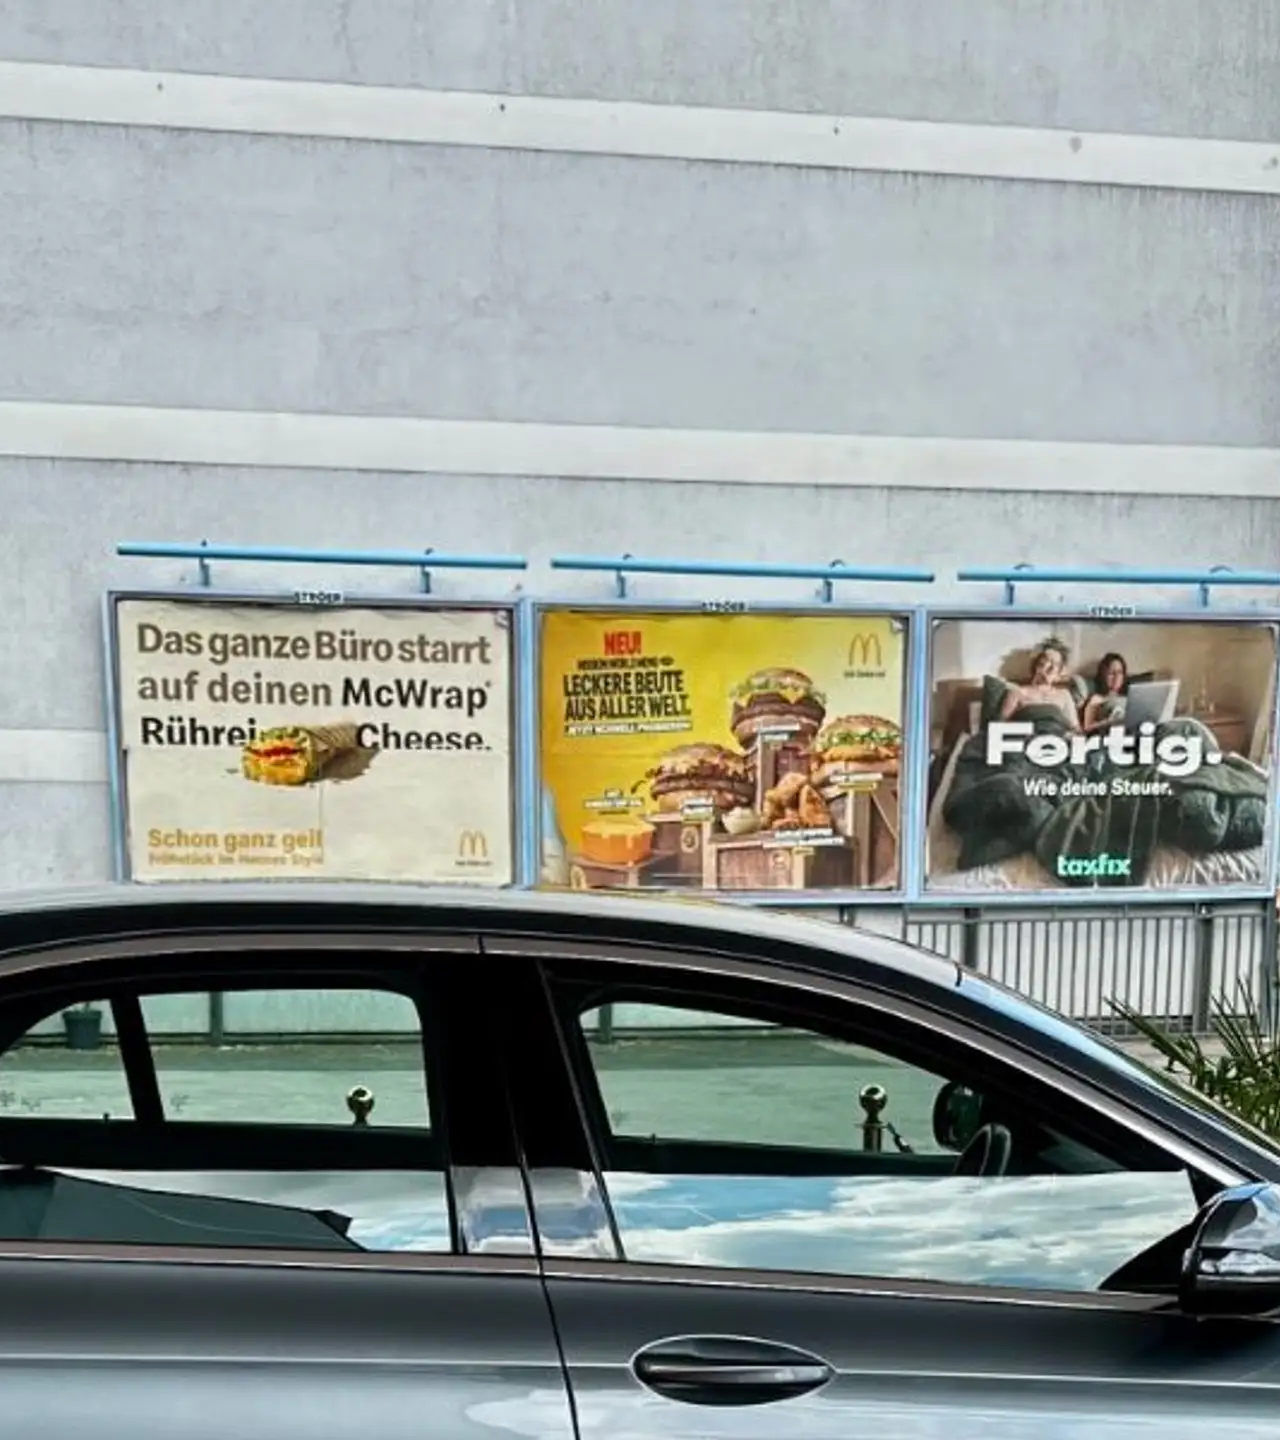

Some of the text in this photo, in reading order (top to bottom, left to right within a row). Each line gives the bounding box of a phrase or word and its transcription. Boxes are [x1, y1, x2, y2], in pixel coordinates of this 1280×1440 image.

[137, 622, 492, 665] Das ganze Büro starrt
[604, 631, 642, 656] NEU!
[138, 670, 200, 701] auf
[207, 672, 332, 706] deinen
[563, 669, 684, 697] LECKERE BEUTE
[565, 697, 597, 721] AUS
[599, 695, 647, 720] ALLER
[141, 715, 257, 746] Rührei
[1023, 777, 1173, 796] Wie deine Steuer.
[148, 828, 219, 848] Schon
[224, 832, 277, 853] ganz
[1057, 853, 1132, 877] taxfix
